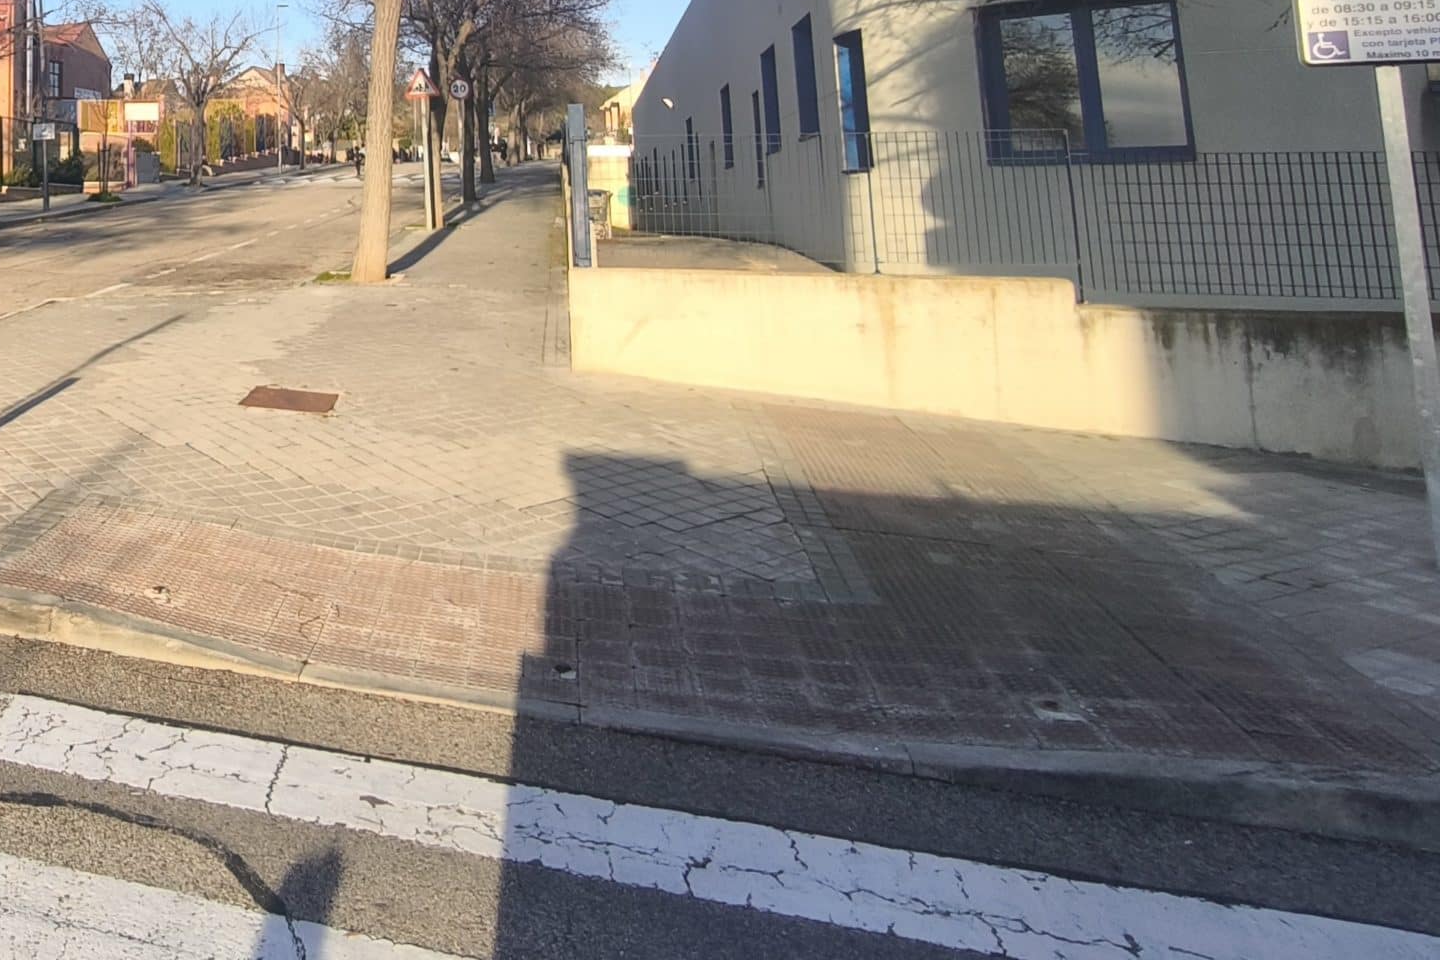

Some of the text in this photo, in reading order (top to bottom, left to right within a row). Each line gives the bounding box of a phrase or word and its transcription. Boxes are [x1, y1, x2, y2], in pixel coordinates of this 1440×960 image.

[1312, 0, 1436, 15] de 08:30 a 09:15
[1319, 18, 1337, 27] de
[1344, 15, 1383, 26] 15:15
[1389, 16, 1397, 25] a
[1353, 28, 1402, 37] Excepto
[1361, 37, 1440, 48] con tarjeta P
[453, 84, 466, 93] 20
